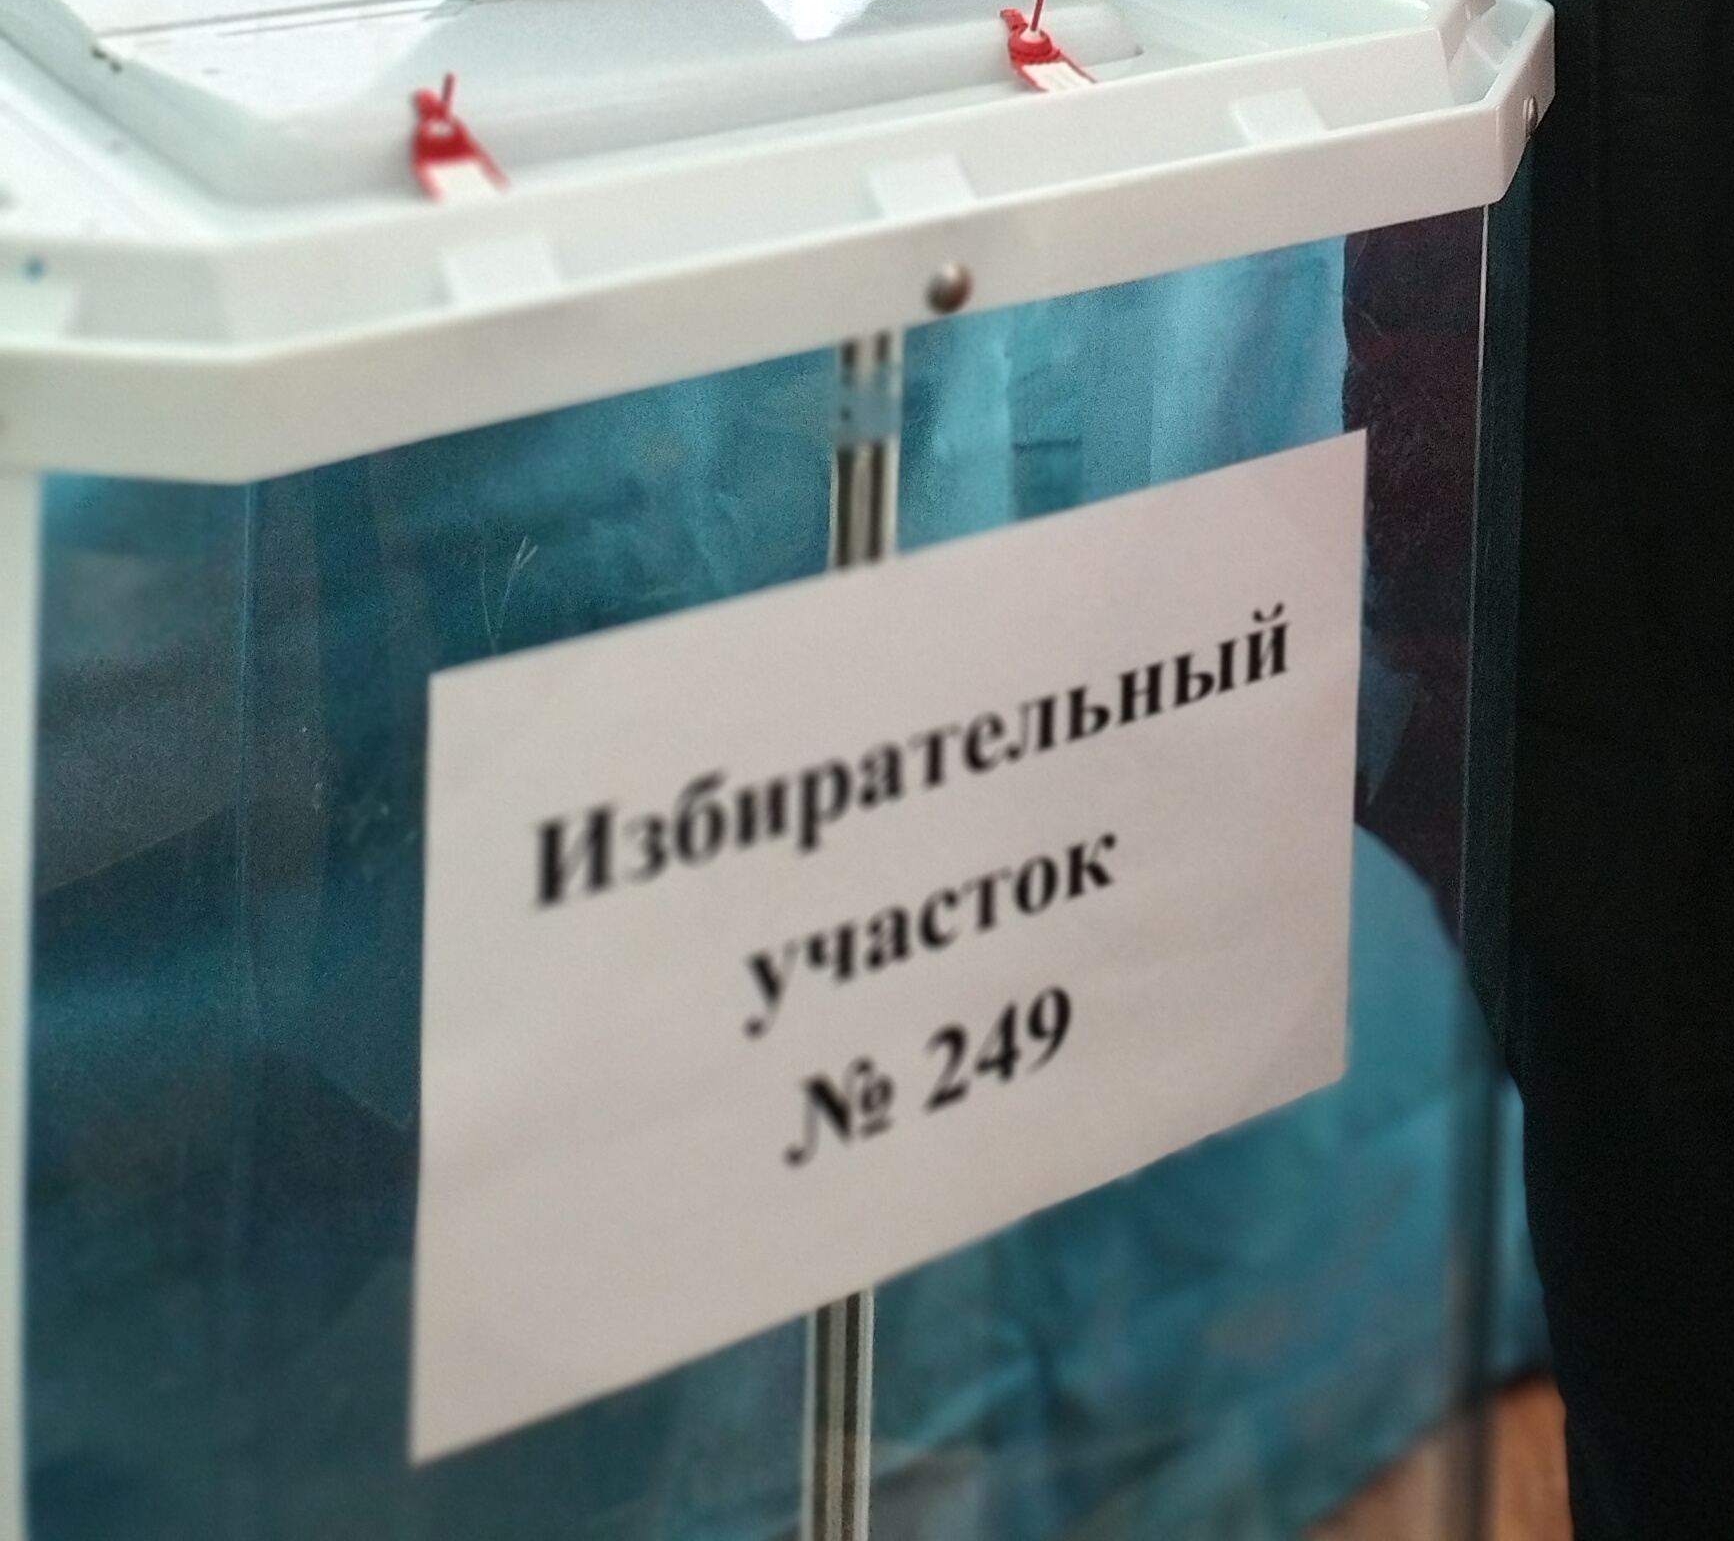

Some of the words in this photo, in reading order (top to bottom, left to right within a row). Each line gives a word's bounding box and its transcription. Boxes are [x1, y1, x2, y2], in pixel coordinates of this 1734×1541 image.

[530, 601, 1290, 911] Избирательный
[744, 831, 1119, 1039] участок
[783, 1055, 897, 1168] №
[924, 984, 1073, 1114] 249
